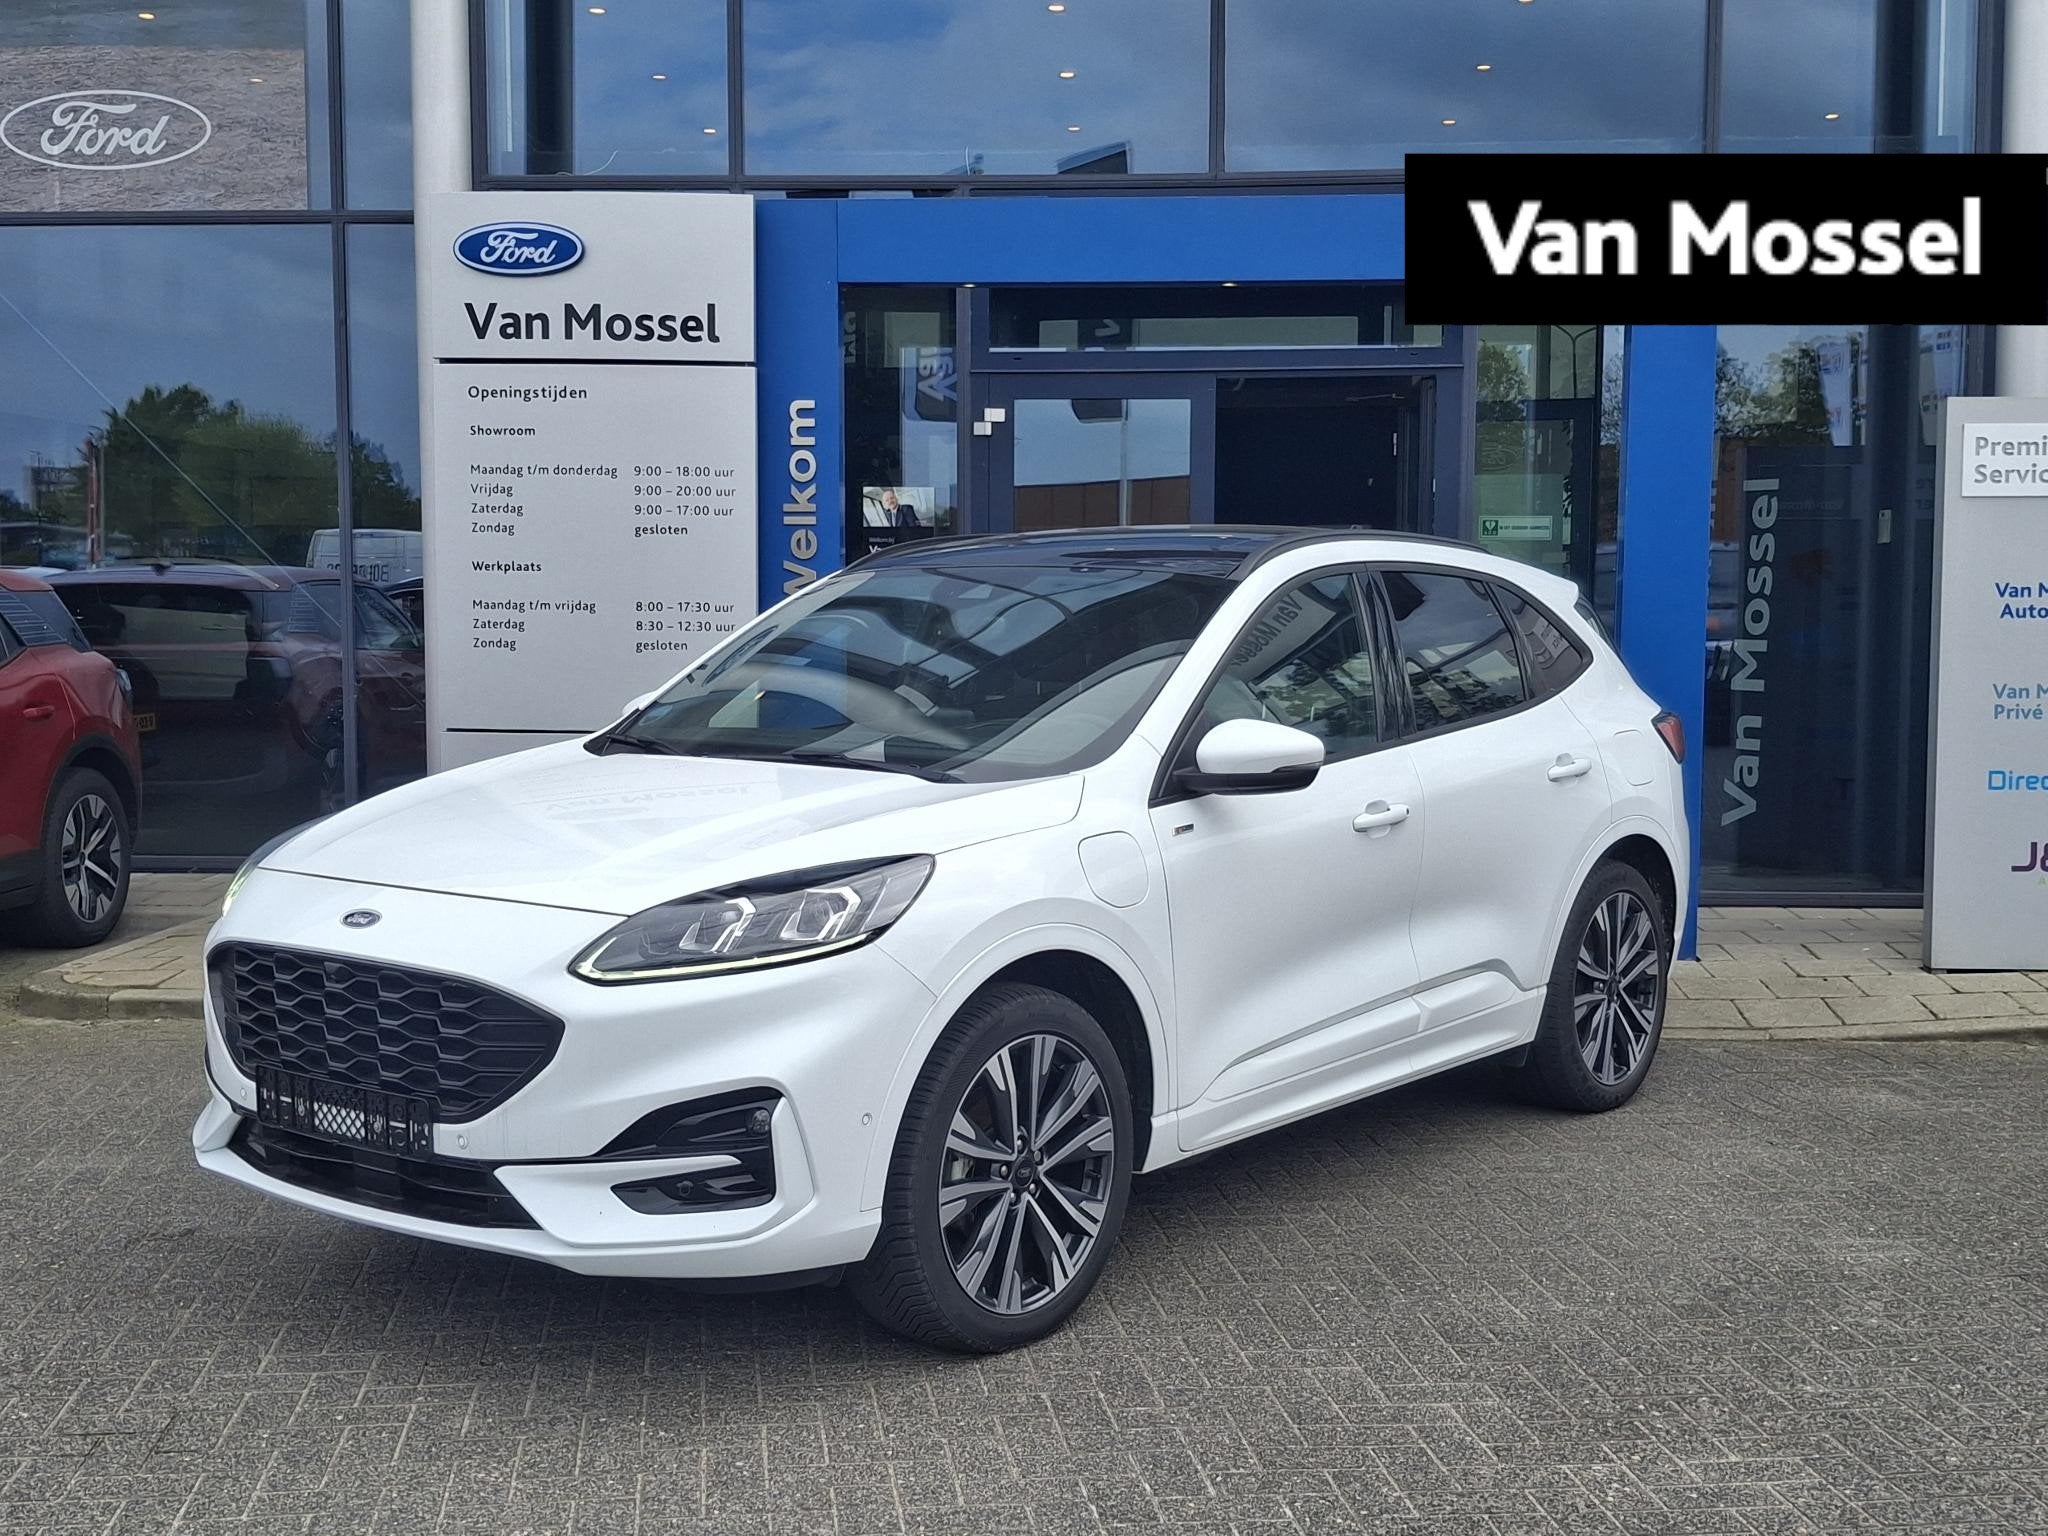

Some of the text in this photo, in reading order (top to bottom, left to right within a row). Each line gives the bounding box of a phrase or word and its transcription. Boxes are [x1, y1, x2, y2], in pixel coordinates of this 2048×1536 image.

[41, 101, 169, 155] Ford
[480, 231, 557, 264] Ford
[464, 303, 720, 343] Van Mossel
[468, 386, 586, 402] Openingstijden
[471, 425, 535, 435] Showroom
[1976, 435, 2047, 456] Premi
[471, 464, 617, 479] Maandag t/m donderdag
[634, 466, 661, 476] 9:00
[677, 467, 710, 476] 18:00
[1974, 463, 2048, 483] Servic
[471, 483, 513, 497] Vrijdag
[635, 485, 661, 495] 9:00
[677, 486, 711, 496] 20:00
[783, 400, 817, 595] Welkom
[472, 503, 523, 516] Zaterdag
[635, 505, 662, 515] 9:00
[677, 506, 709, 515] 17:00
[472, 522, 514, 536] Zondag
[635, 524, 687, 537] gesloten
[472, 561, 541, 574] Werkplaats
[1995, 583, 2031, 597] Van
[473, 600, 596, 614] Maandag t/m vrijdag
[636, 602, 663, 611] 8:00
[678, 602, 710, 612] 17:30
[2000, 603, 2048, 618] Auto
[473, 618, 525, 632] Zaterdag
[636, 621, 663, 631] 8:30
[678, 621, 711, 631] 12:30
[474, 638, 516, 651] Zondag
[636, 640, 687, 653] gesloten
[1721, 478, 1780, 826] Van Mossel
[1993, 684, 2029, 699] Van
[1994, 704, 2043, 719] Privé
